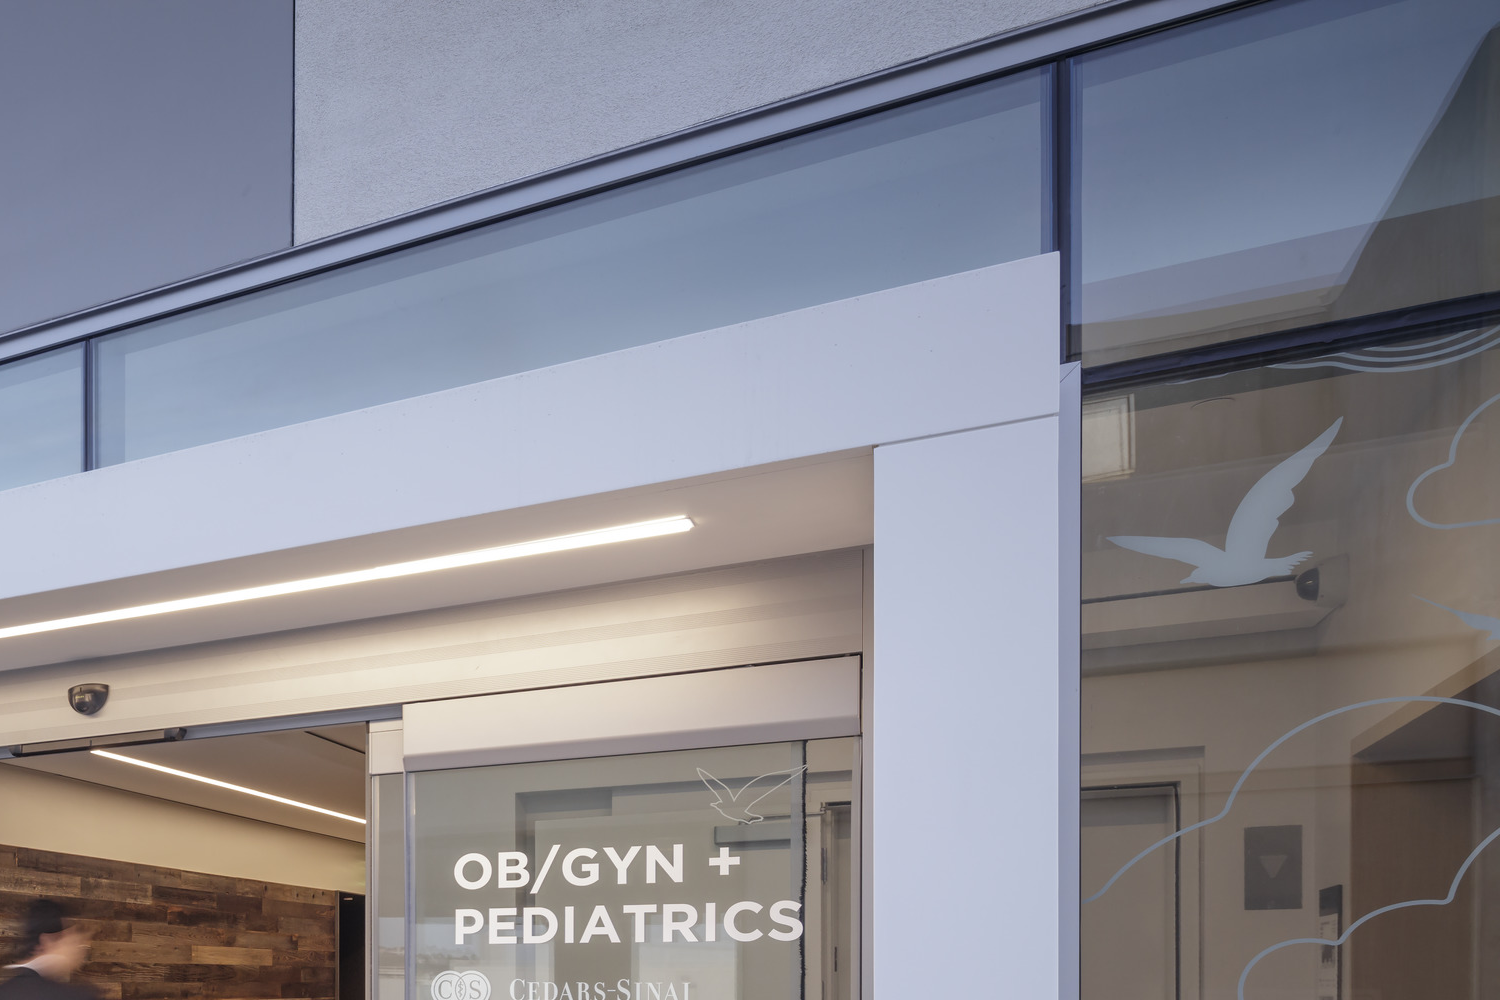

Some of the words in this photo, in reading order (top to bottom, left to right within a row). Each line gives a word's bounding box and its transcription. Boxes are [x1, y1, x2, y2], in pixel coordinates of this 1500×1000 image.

[453, 844, 684, 894] OB/GYN
[708, 846, 741, 876] +
[454, 900, 804, 945] PEDIATRICS
